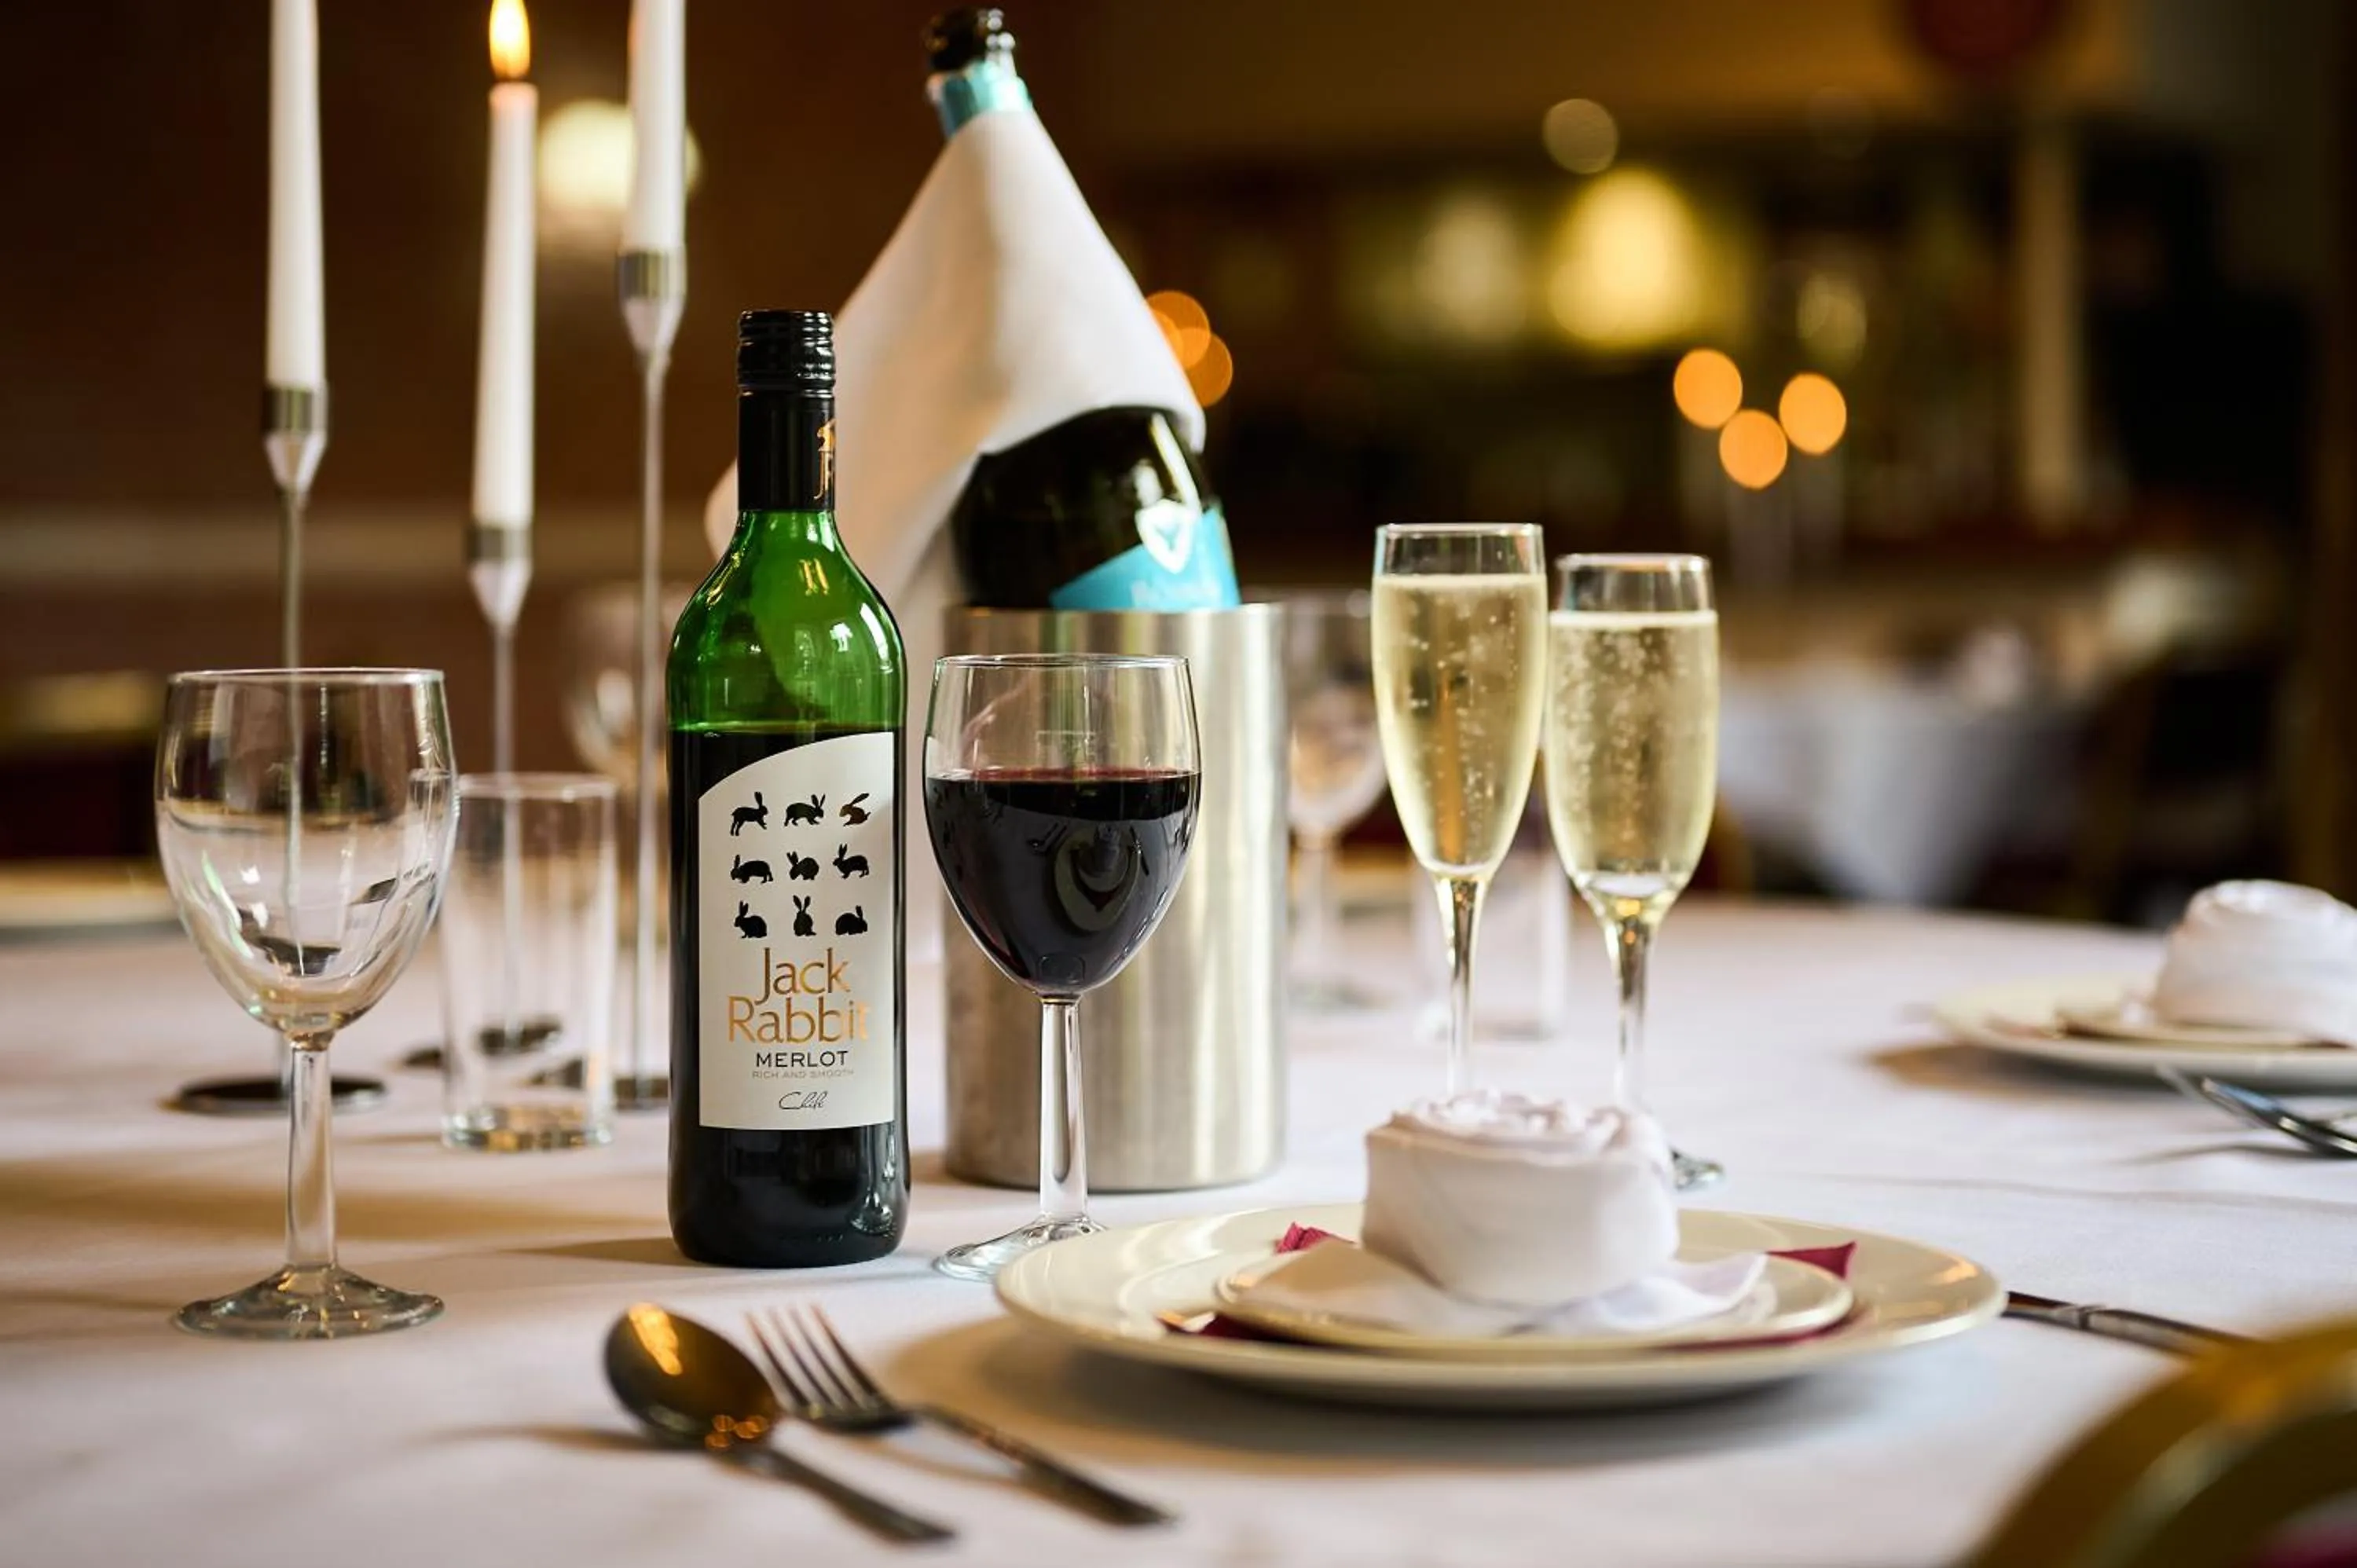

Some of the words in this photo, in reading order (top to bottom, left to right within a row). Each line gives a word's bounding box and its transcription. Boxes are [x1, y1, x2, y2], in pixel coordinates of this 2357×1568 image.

[754, 947, 850, 1005] Jack
[728, 996, 869, 1043] Rabbit
[752, 1071, 779, 1079] RICH
[783, 1070, 806, 1079] AND
[756, 1050, 849, 1068] MERLOT
